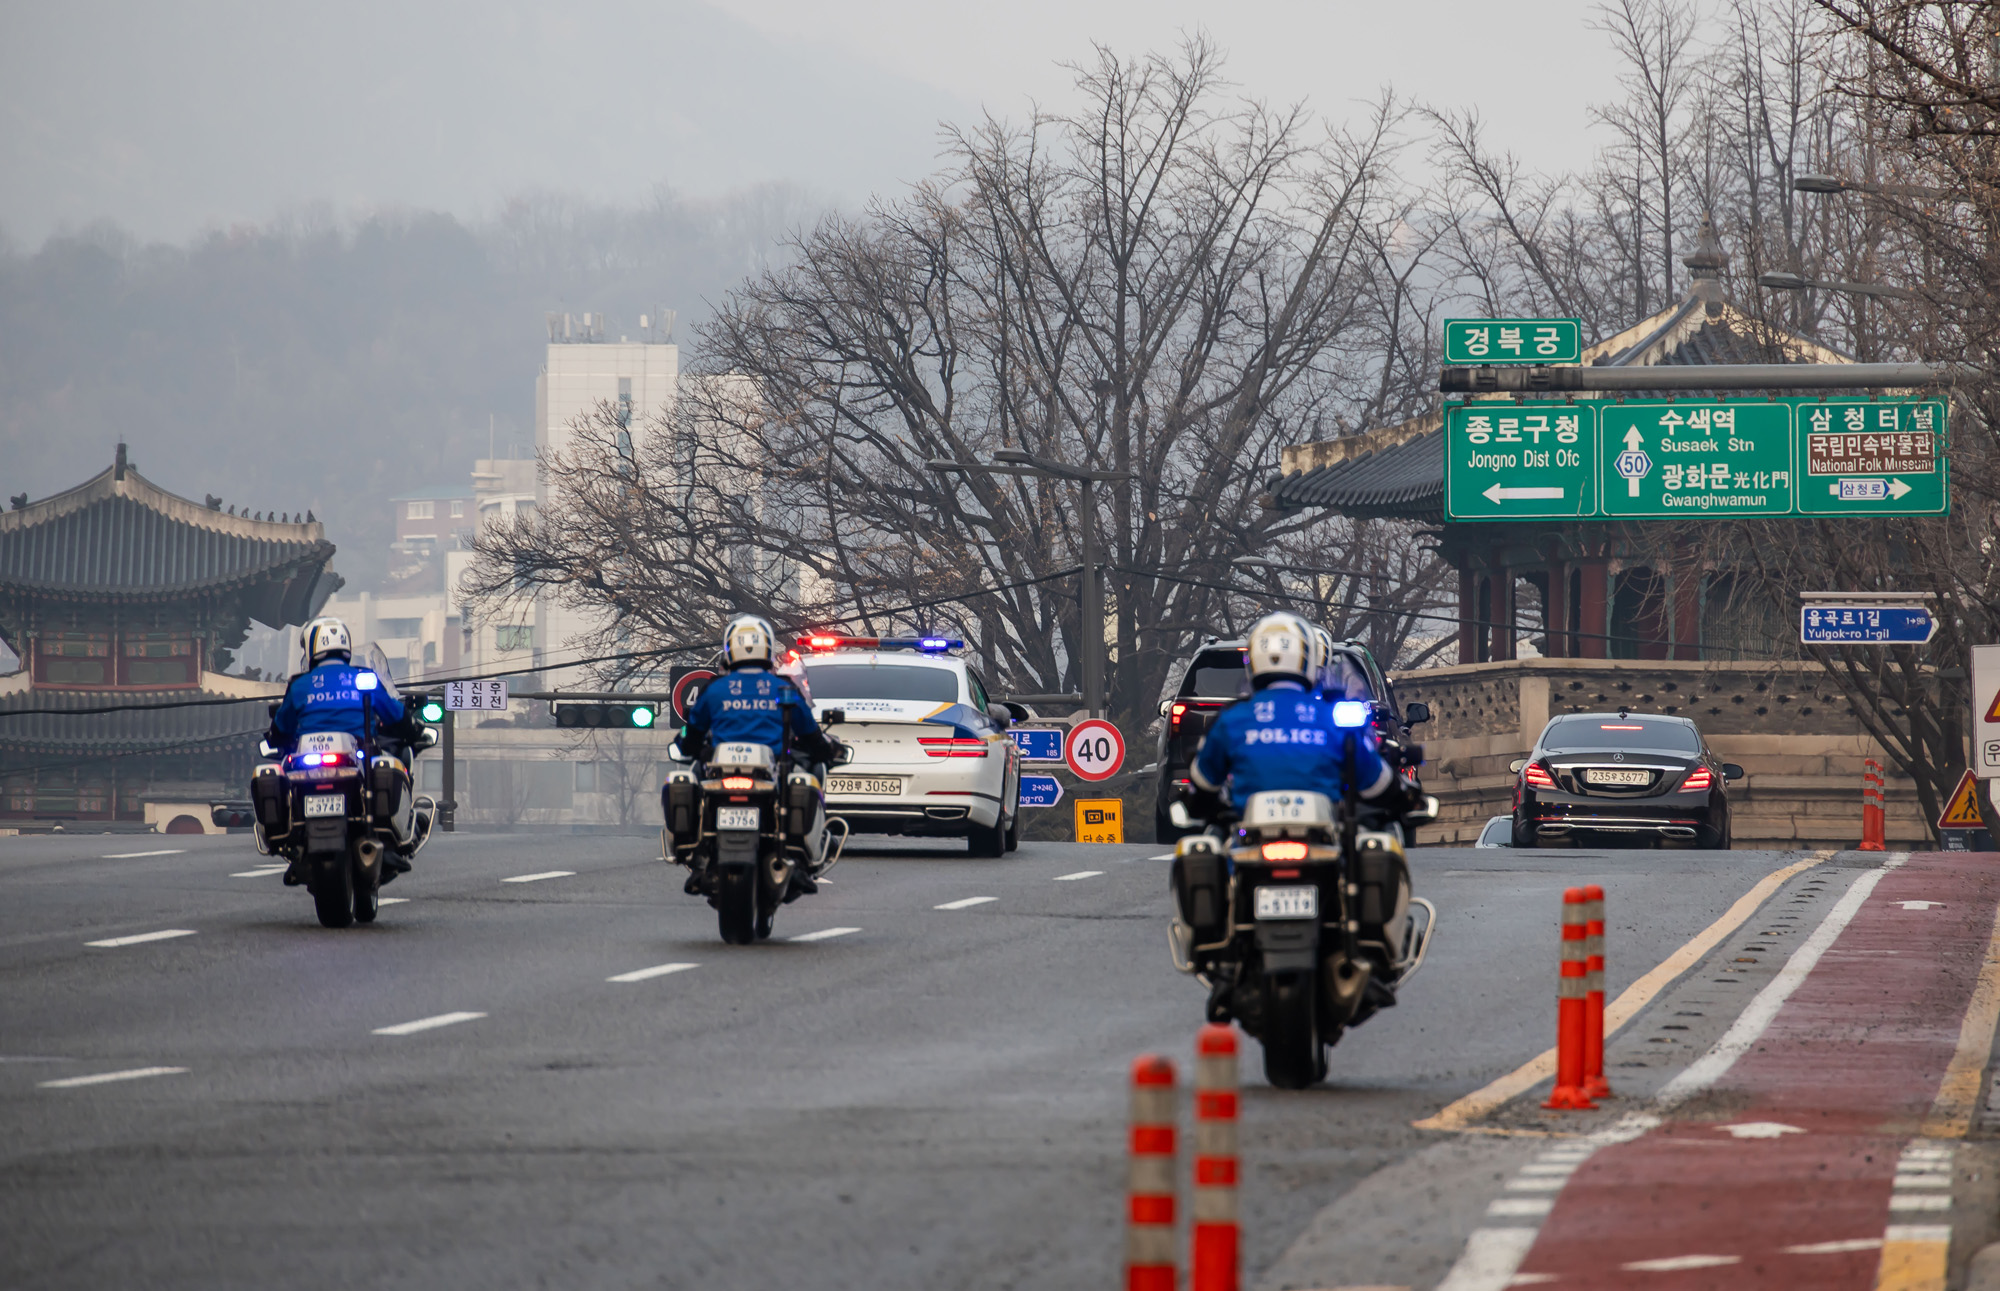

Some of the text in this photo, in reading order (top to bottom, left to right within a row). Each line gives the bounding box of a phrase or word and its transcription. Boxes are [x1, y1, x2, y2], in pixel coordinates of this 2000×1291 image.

[1464, 327, 1560, 355] 경복궁
[1658, 408, 1735, 435] 수색역
[1810, 406, 1933, 431] 삼청터널
[1465, 415, 1579, 444] 종로구청
[1661, 438, 1754, 452] Susaek Stn
[1812, 434, 1931, 457] 국립민속박물관
[1468, 449, 1580, 472] Jongno Dist Ofc
[1624, 456, 1644, 473] 50
[1812, 457, 1931, 472] National Folk Museum
[1662, 463, 1789, 490] 광화문 光化門
[1843, 483, 1882, 496] 삼청로
[1662, 493, 1766, 509] Gwanghwamun
[1807, 610, 1880, 627] 율곡로1길
[1807, 628, 1889, 640] Yulgok-ro 1-gil
[452, 682, 501, 694] 직진후
[307, 690, 359, 704] POLICE
[452, 696, 501, 708] 좌회전
[722, 699, 778, 711] POLICE
[1245, 728, 1328, 746] POLICE
[1077, 737, 1110, 763] 40
[865, 780, 896, 792] 3056
